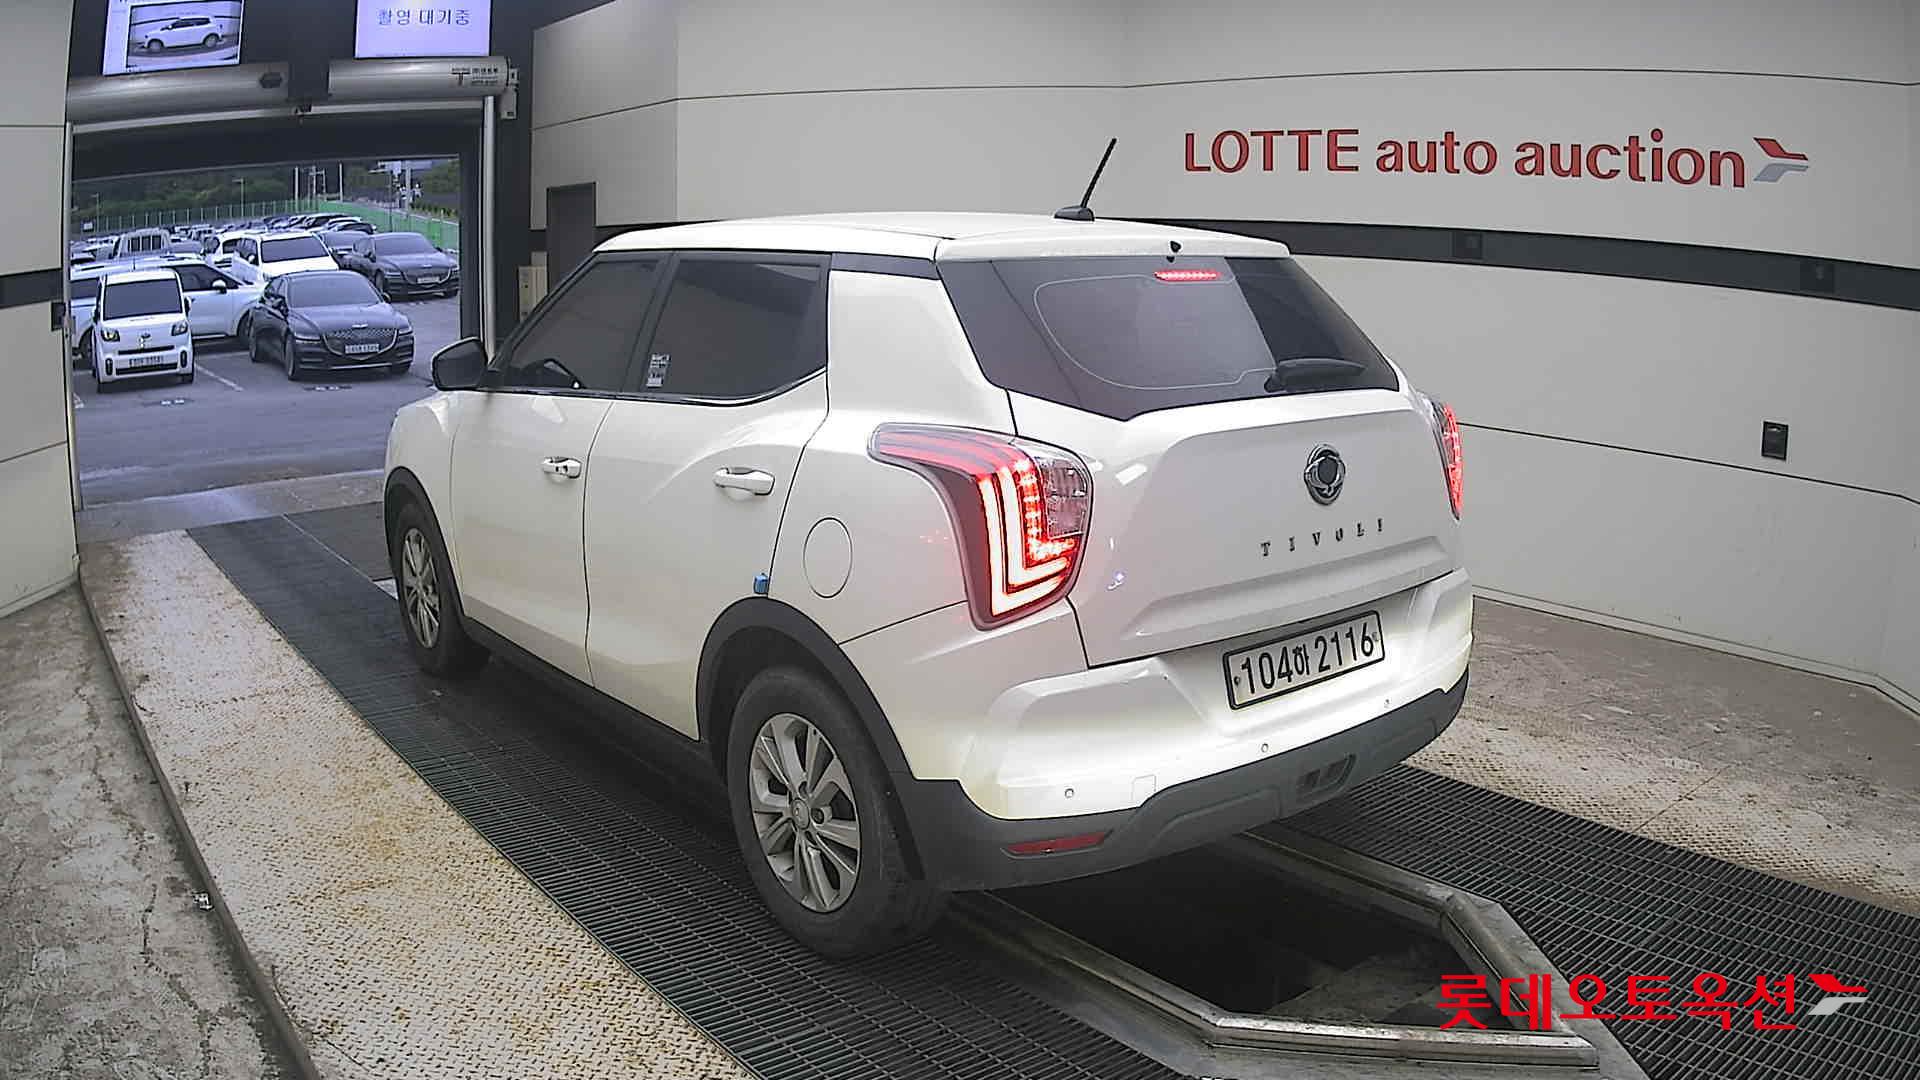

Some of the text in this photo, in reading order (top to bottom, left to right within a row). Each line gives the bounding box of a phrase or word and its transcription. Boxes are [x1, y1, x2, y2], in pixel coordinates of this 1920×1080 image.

[419, 9, 470, 26] 대기중
[1184, 128, 1747, 188] LOTTE auto auction
[1260, 517, 1384, 557] TIVOLI
